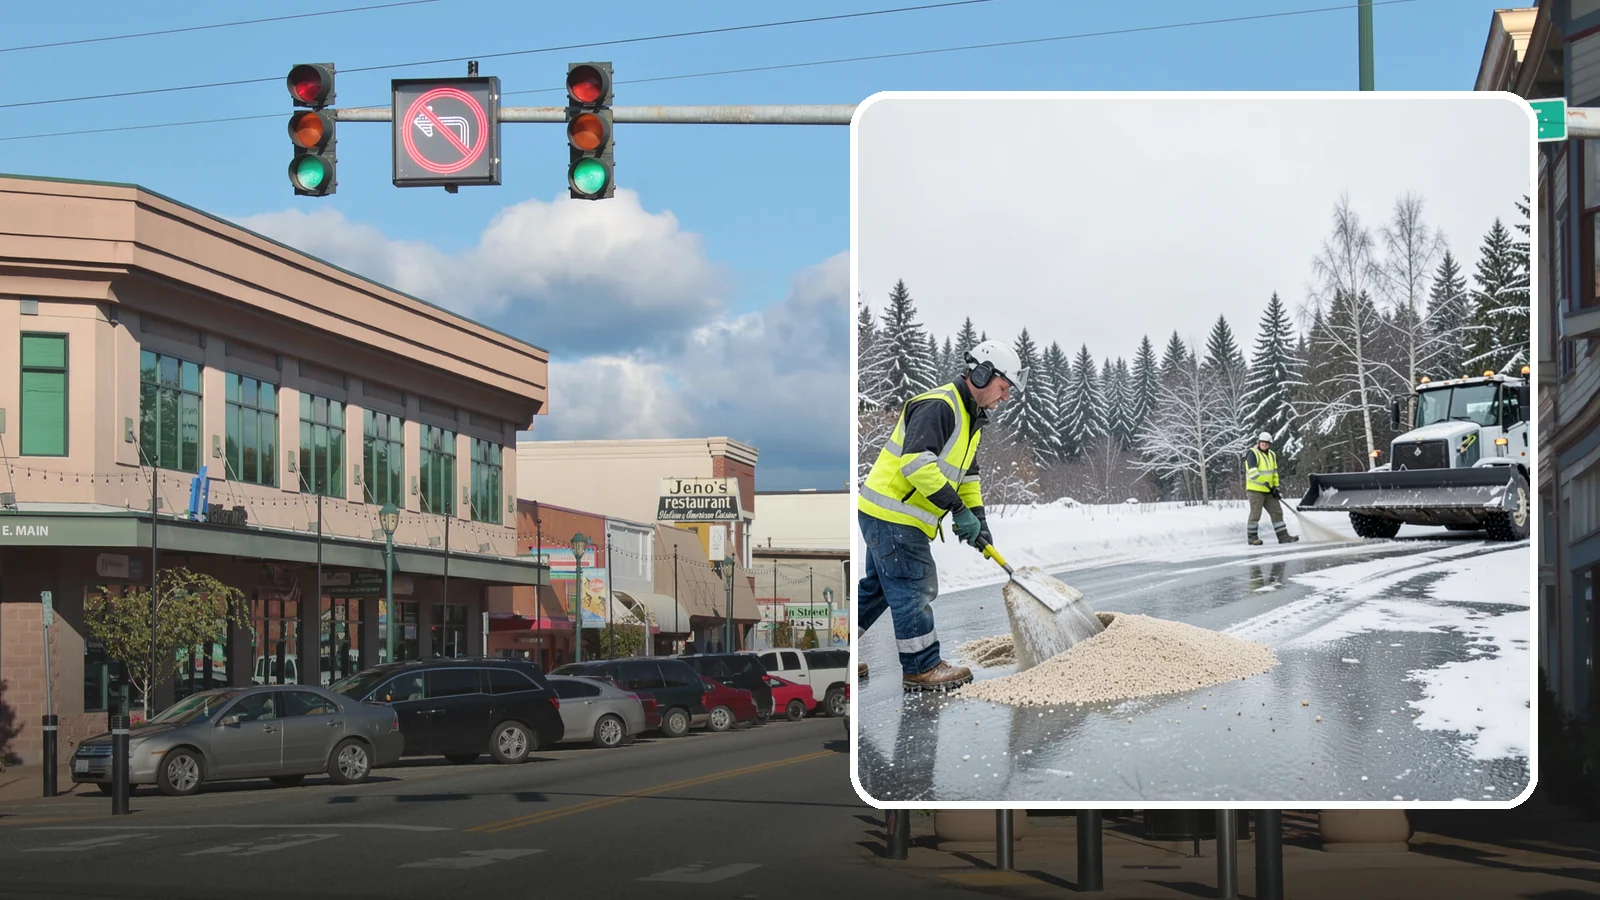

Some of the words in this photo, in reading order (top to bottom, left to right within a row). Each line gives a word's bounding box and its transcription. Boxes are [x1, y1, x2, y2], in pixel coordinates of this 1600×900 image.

[670, 480, 728, 494] Jeno's
[665, 496, 731, 509] restaurant
[658, 510, 681, 520] Italian
[686, 509, 715, 519] American
[715, 509, 738, 519] Cuisine
[2, 525, 13, 536] E.
[15, 525, 49, 536] MAIN
[797, 607, 828, 617] Street
